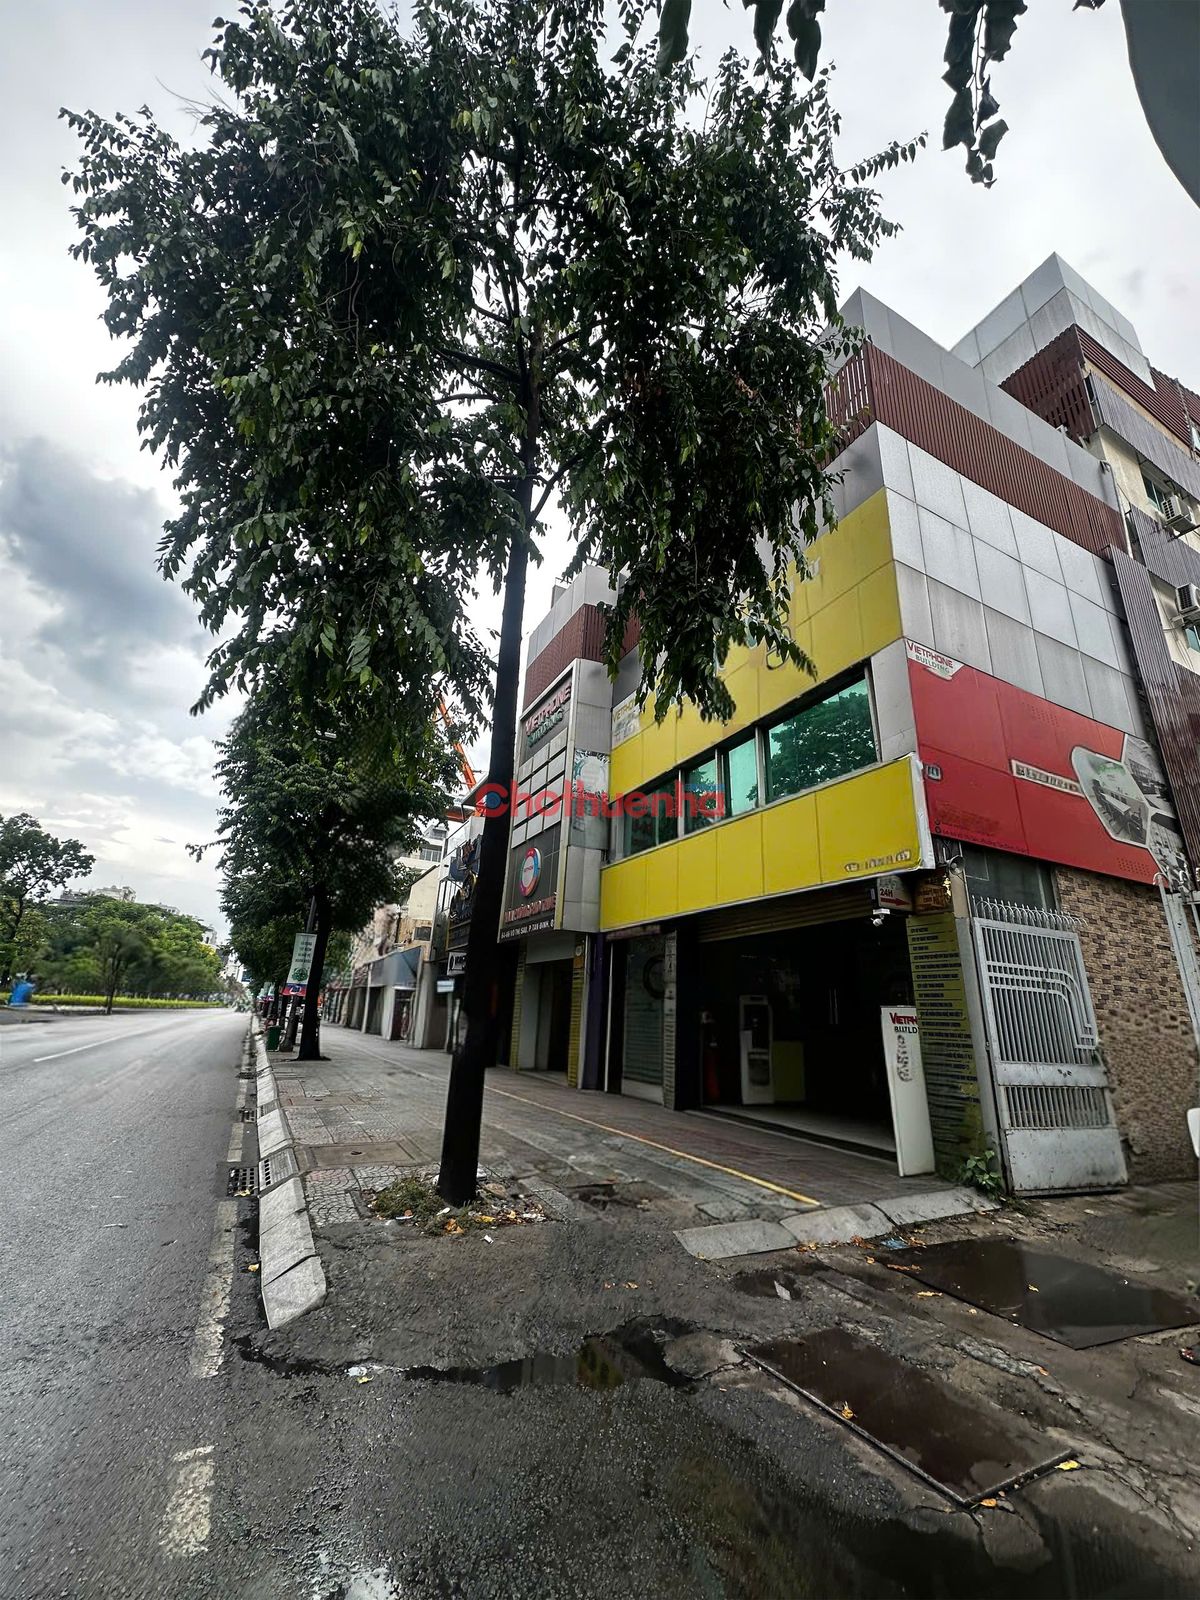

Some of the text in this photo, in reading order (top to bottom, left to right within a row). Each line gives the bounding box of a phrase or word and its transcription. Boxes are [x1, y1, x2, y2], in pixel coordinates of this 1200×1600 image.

[906, 640, 954, 669] VIETPHONE
[915, 654, 950, 674] BUILDING
[889, 1012, 918, 1025] VIETPH
[894, 1026, 918, 1034] BUILD
